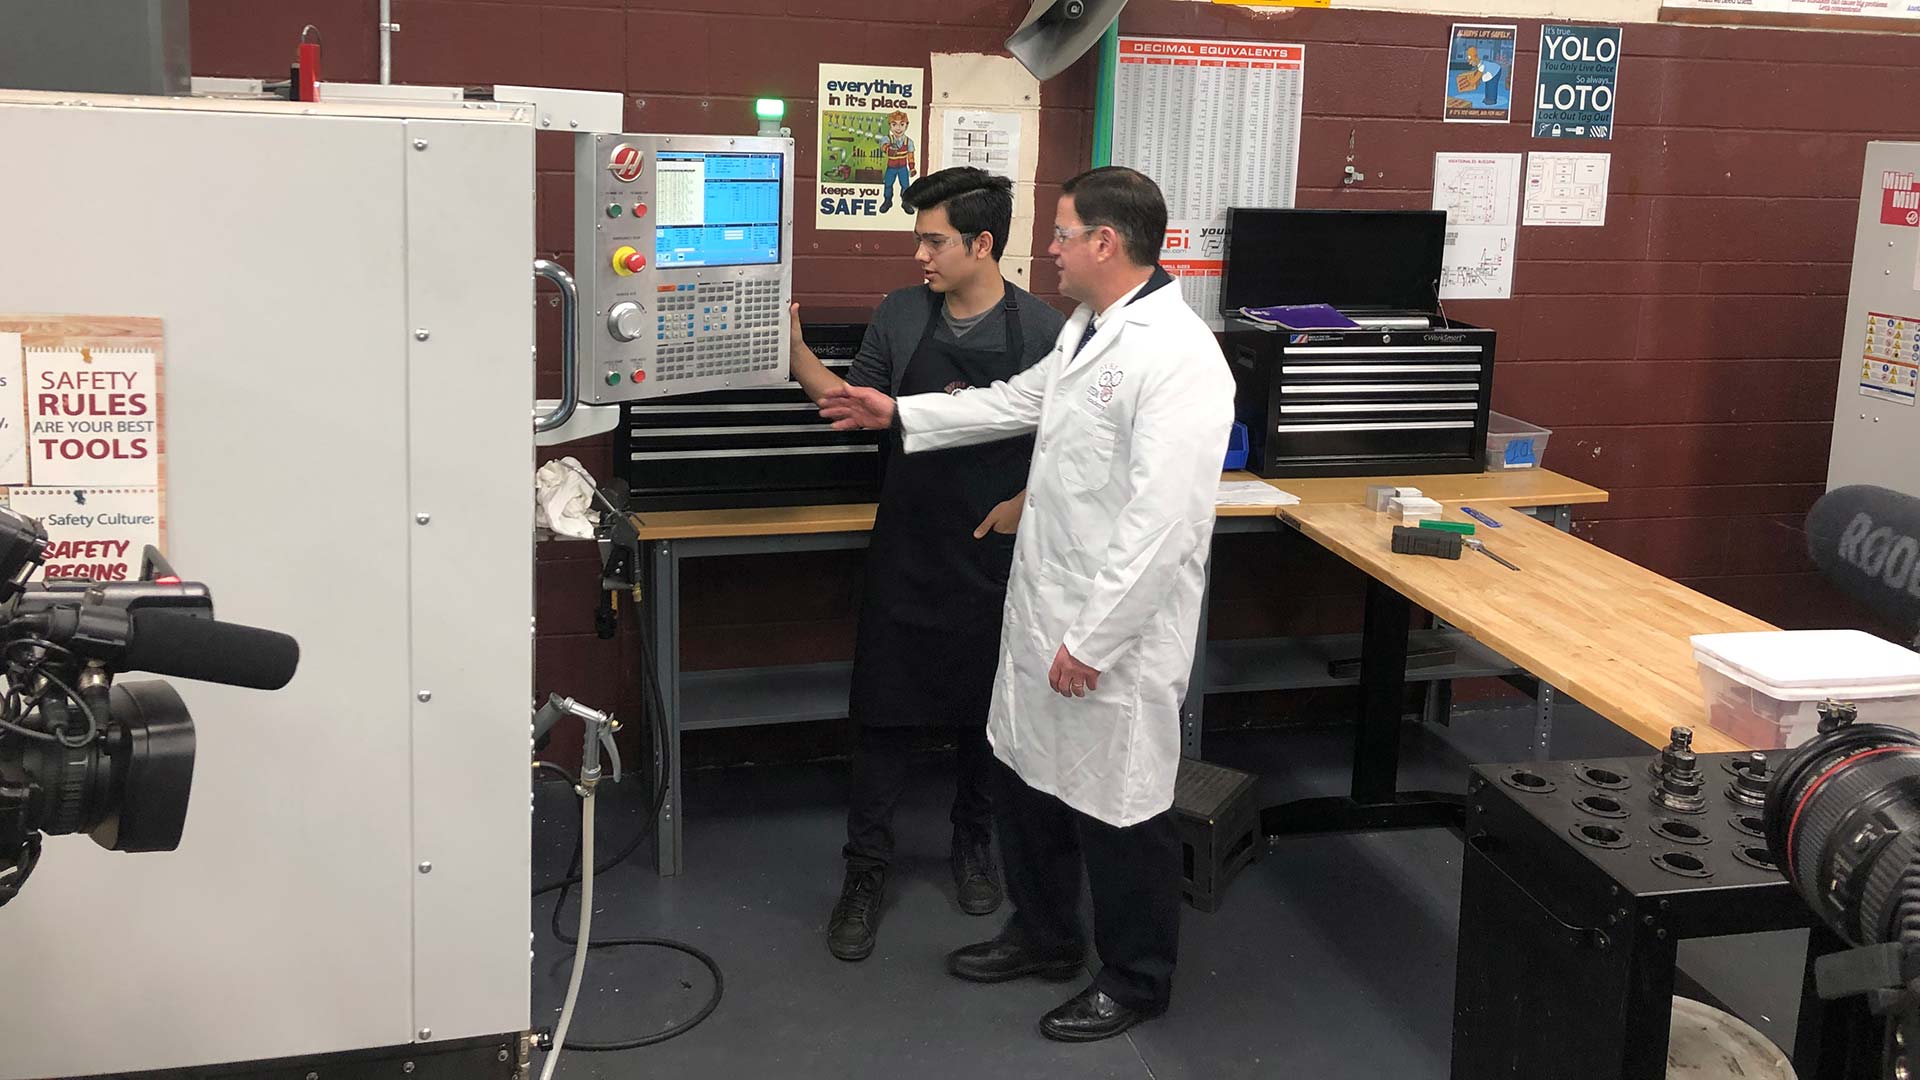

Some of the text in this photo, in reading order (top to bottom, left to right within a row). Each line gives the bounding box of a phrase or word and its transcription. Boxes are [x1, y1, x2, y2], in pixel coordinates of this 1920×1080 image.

[1545, 26, 1556, 35] It's
[1134, 43, 1288, 58] DECIMAL EQUIVALENTS
[1544, 35, 1616, 63] YOLO
[1545, 62, 1614, 73] You Only Live Once
[827, 79, 913, 98] everything
[1576, 75, 1586, 84] So
[828, 93, 918, 111] in it's place...
[1538, 83, 1613, 112] LOTO
[1538, 111, 1609, 123] Lock Out Tag Out
[1881, 170, 1915, 190] Mini
[820, 184, 880, 198] keeps you
[1892, 190, 1920, 210] Mill
[820, 197, 878, 216] SAFE
[41, 371, 138, 390] SAFETY
[38, 393, 148, 416] RULES
[33, 421, 155, 433] ARE YOUR BEST
[38, 438, 148, 460] TOOLS
[48, 513, 95, 528] Safety
[97, 513, 155, 525] Culture:
[42, 539, 130, 559] SAFETY
[44, 562, 129, 581] BEGINS
